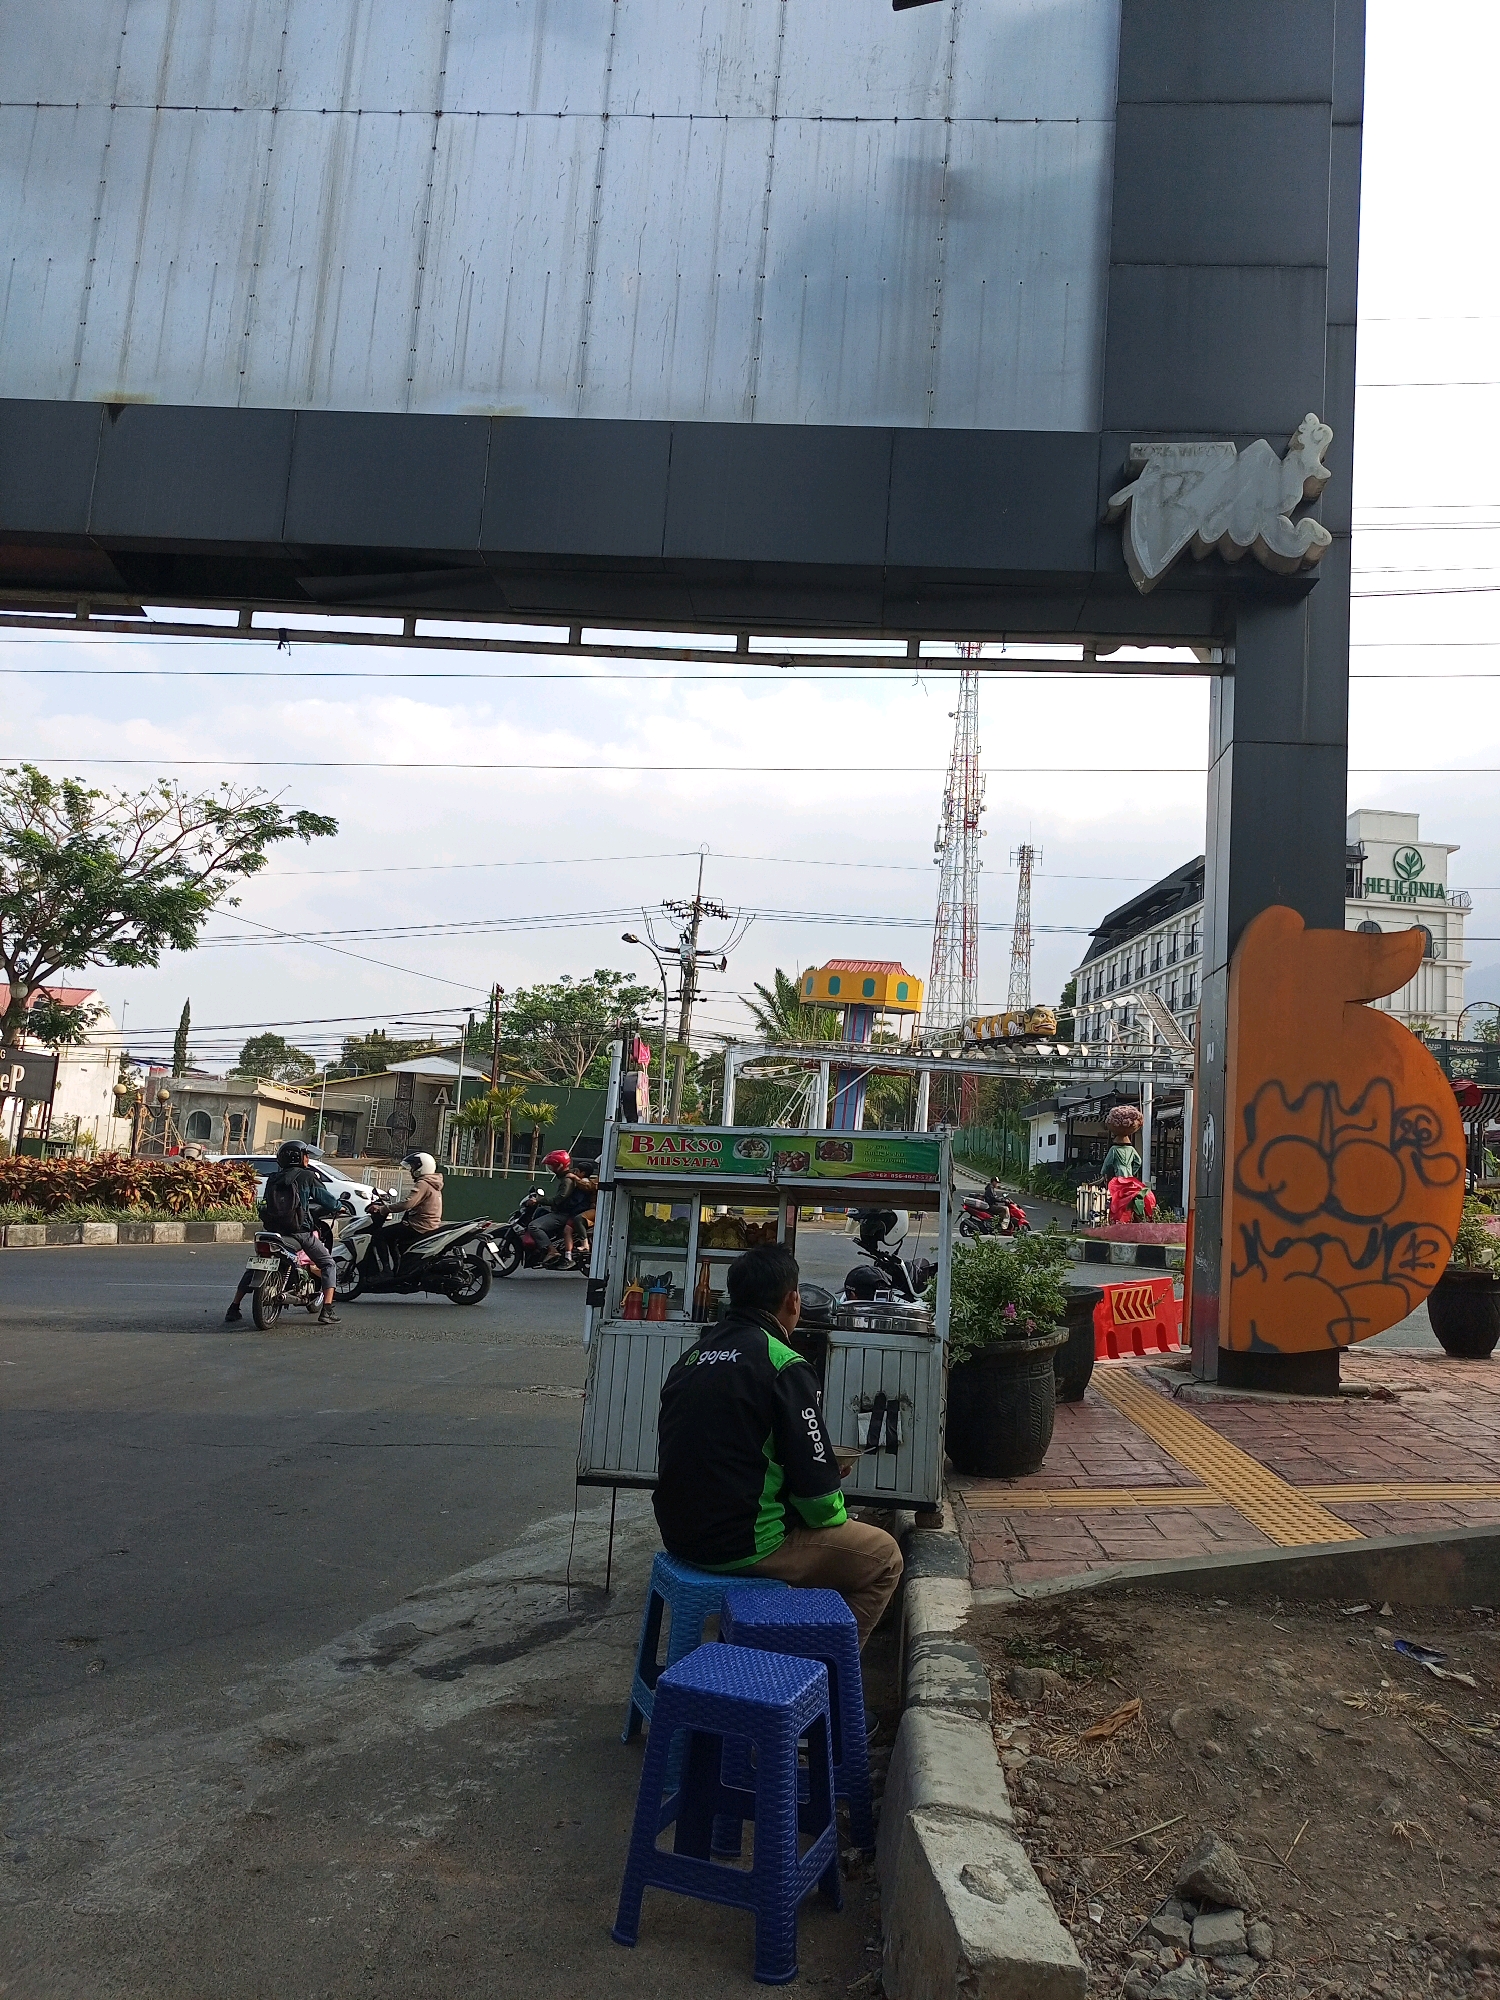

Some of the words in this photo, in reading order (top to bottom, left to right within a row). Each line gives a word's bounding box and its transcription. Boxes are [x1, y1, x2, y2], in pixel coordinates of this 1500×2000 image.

[1365, 877, 1445, 900] HELICONIA
[1390, 894, 1417, 903] HOTEL
[1449, 1044, 1484, 1053] INDONESIA
[627, 1134, 723, 1154] BAKSO
[696, 1348, 742, 1366] gojek
[801, 1407, 828, 1464] gopay
